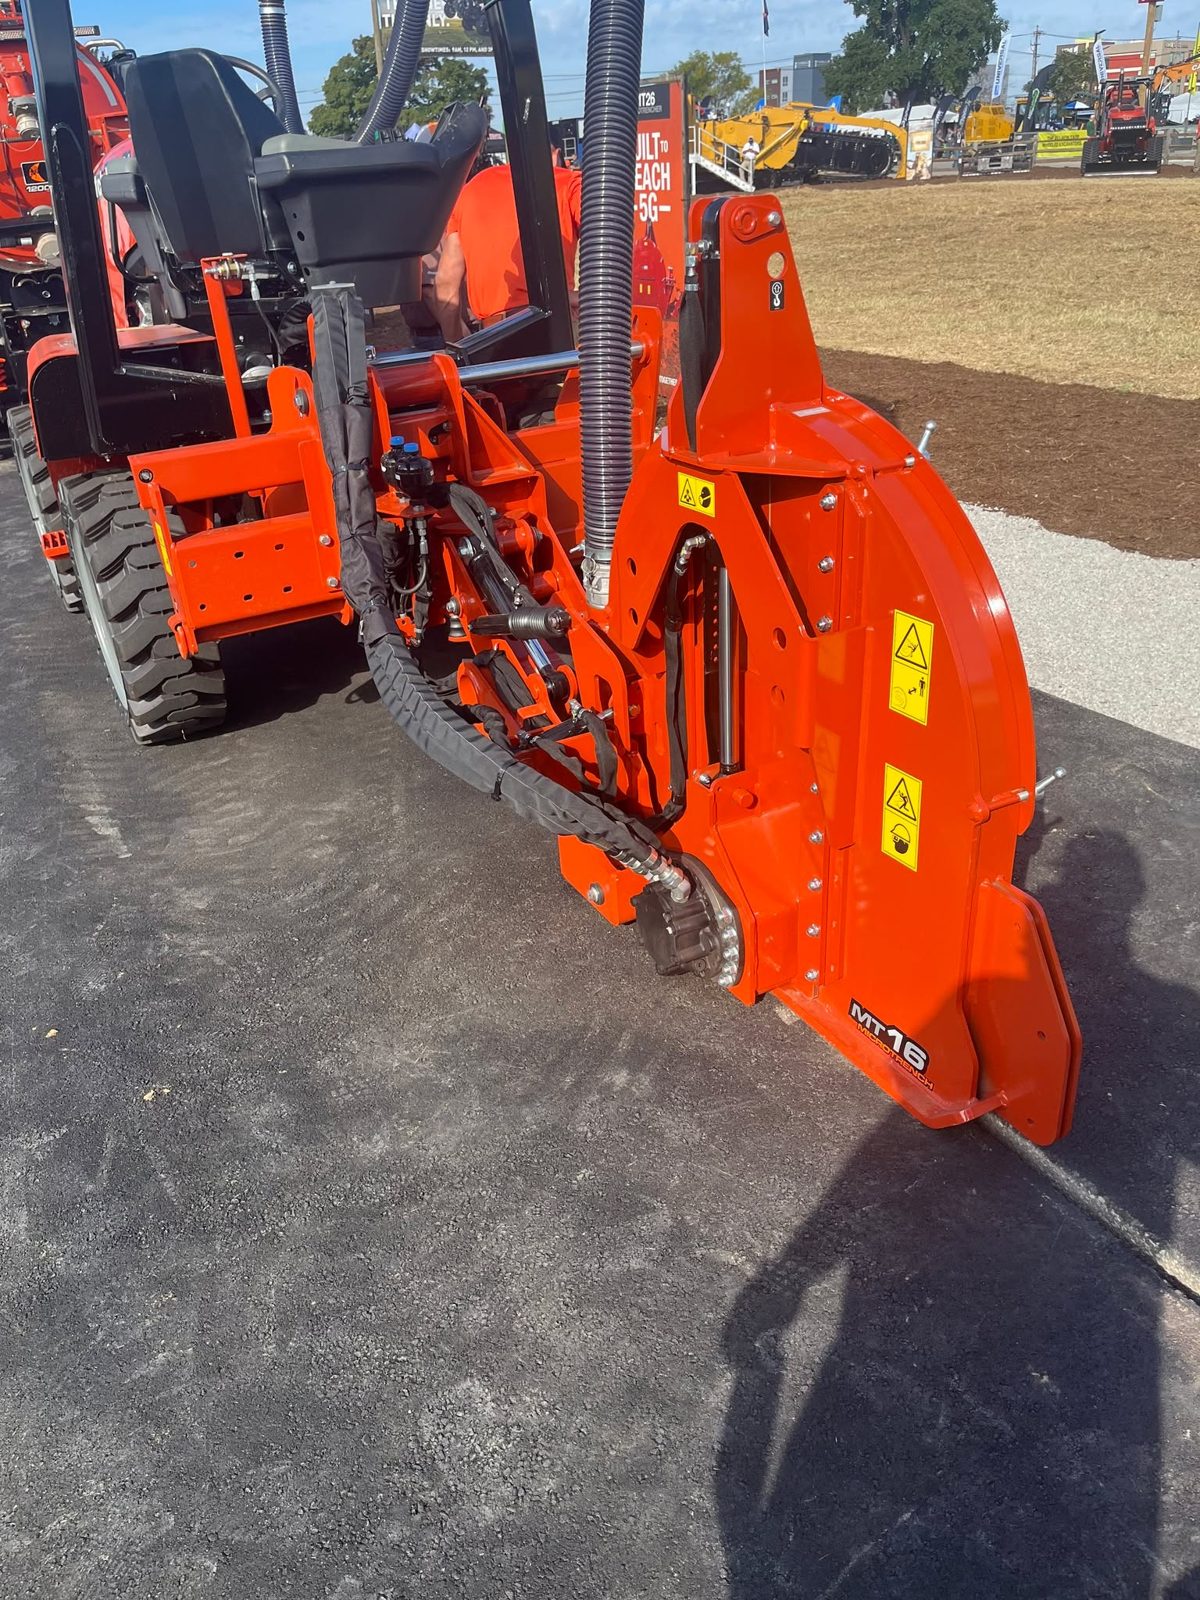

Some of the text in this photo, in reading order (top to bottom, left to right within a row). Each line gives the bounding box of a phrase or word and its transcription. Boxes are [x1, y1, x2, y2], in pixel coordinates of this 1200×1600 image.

[637, 91, 656, 107] T26
[635, 132, 669, 160] UILT TO
[634, 162, 671, 191] EACH
[851, 1002, 927, 1072] MT16
